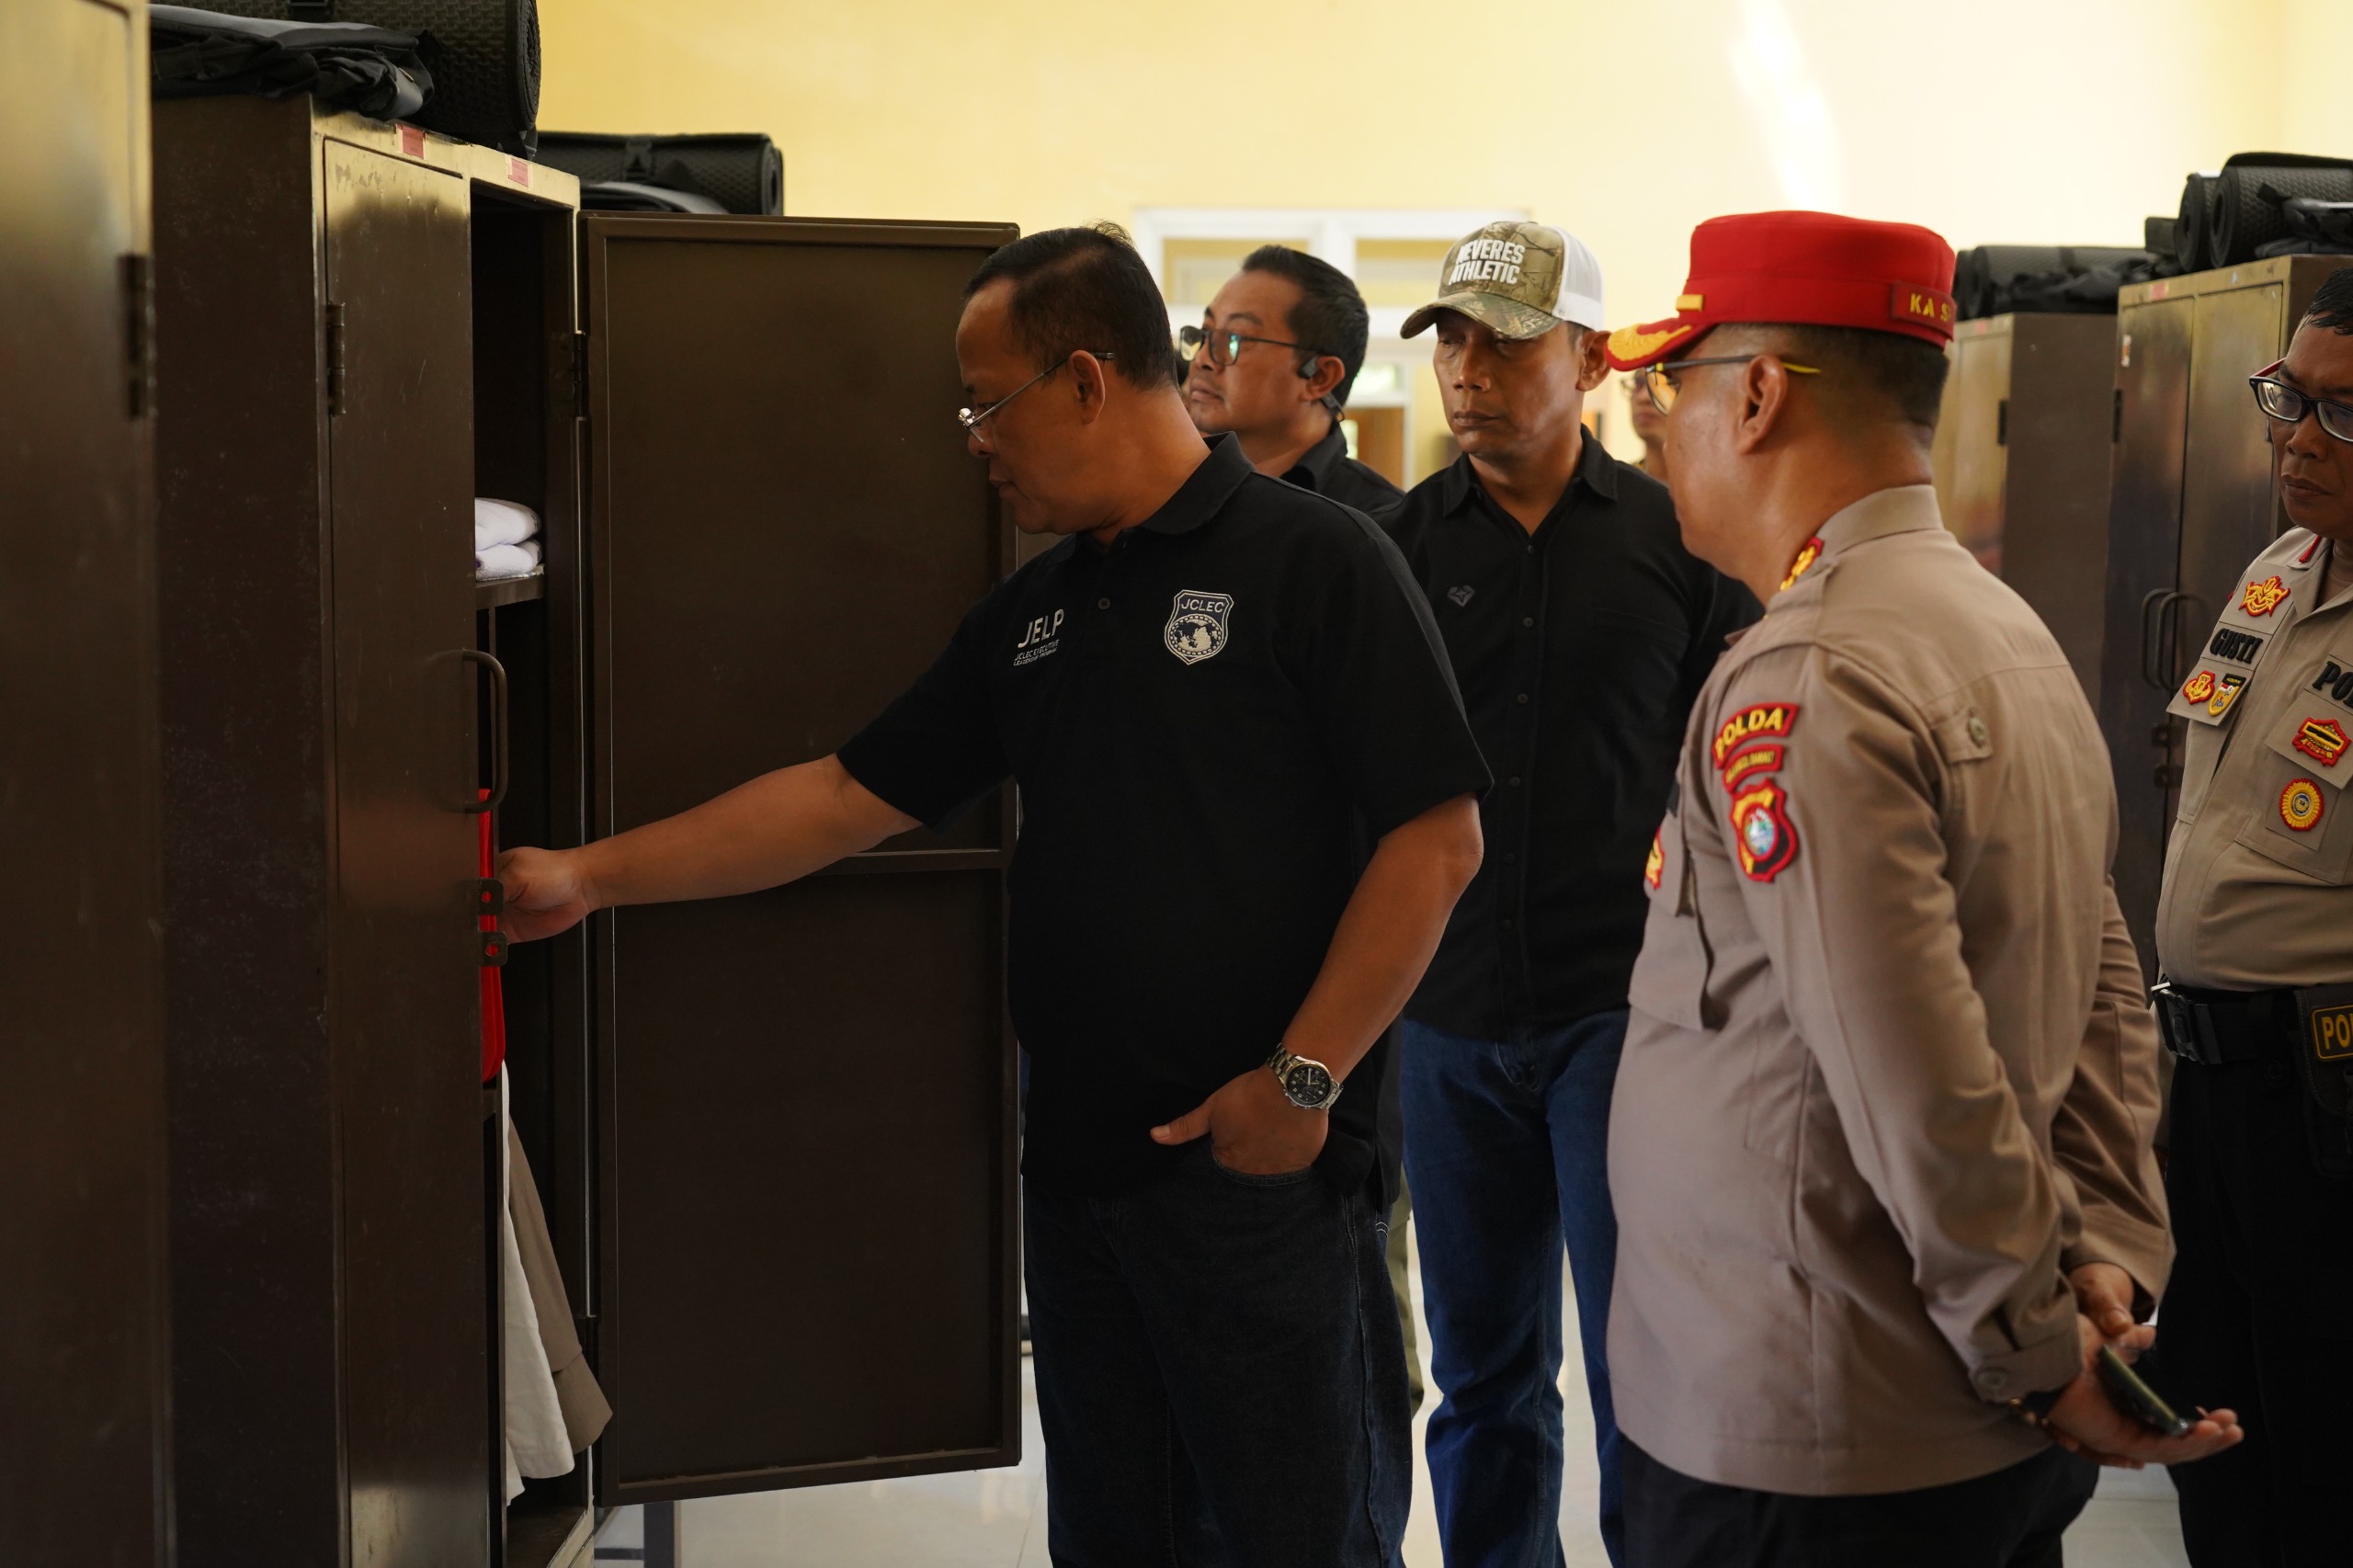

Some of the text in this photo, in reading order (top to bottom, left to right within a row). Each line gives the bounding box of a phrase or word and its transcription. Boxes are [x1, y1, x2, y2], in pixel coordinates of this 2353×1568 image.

[1448, 260, 1520, 286] ATHLETIC
[1910, 293, 1935, 318] KA
[1180, 598, 1225, 613] JCLEC
[1017, 608, 1065, 649] JELP
[2210, 628, 2264, 664] GUSTI
[1713, 707, 1783, 760] POLDA
